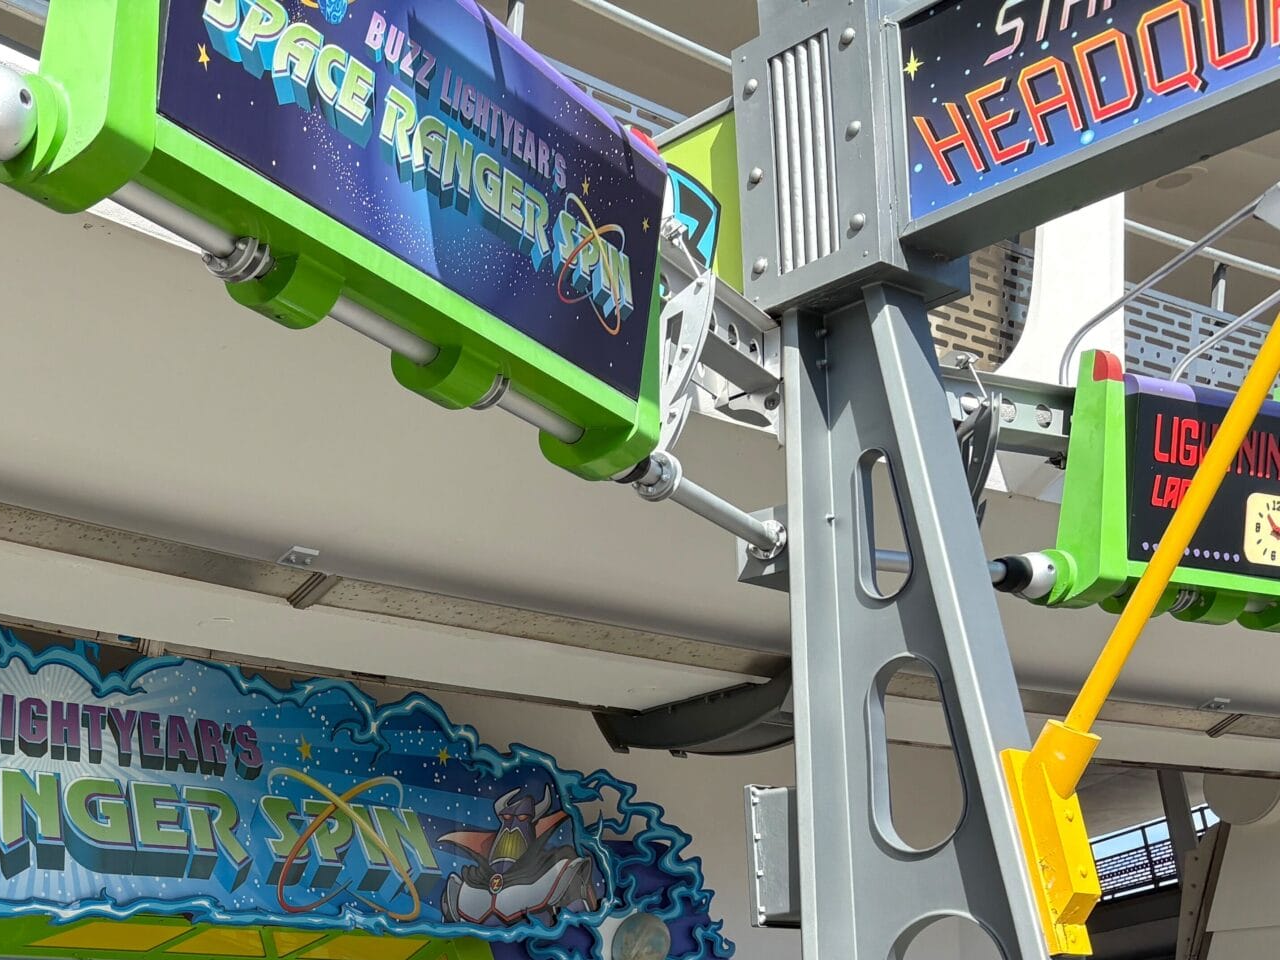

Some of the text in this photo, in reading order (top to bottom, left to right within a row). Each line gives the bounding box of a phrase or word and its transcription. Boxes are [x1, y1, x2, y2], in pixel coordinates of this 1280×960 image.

[364, 11, 568, 190] BUZZ LIGHTYEAR'S
[912, 0, 1280, 185] HEADQU
[379, 85, 551, 259] RANGER
[556, 210, 633, 312] SPIN
[256, 795, 443, 877] SPIN
